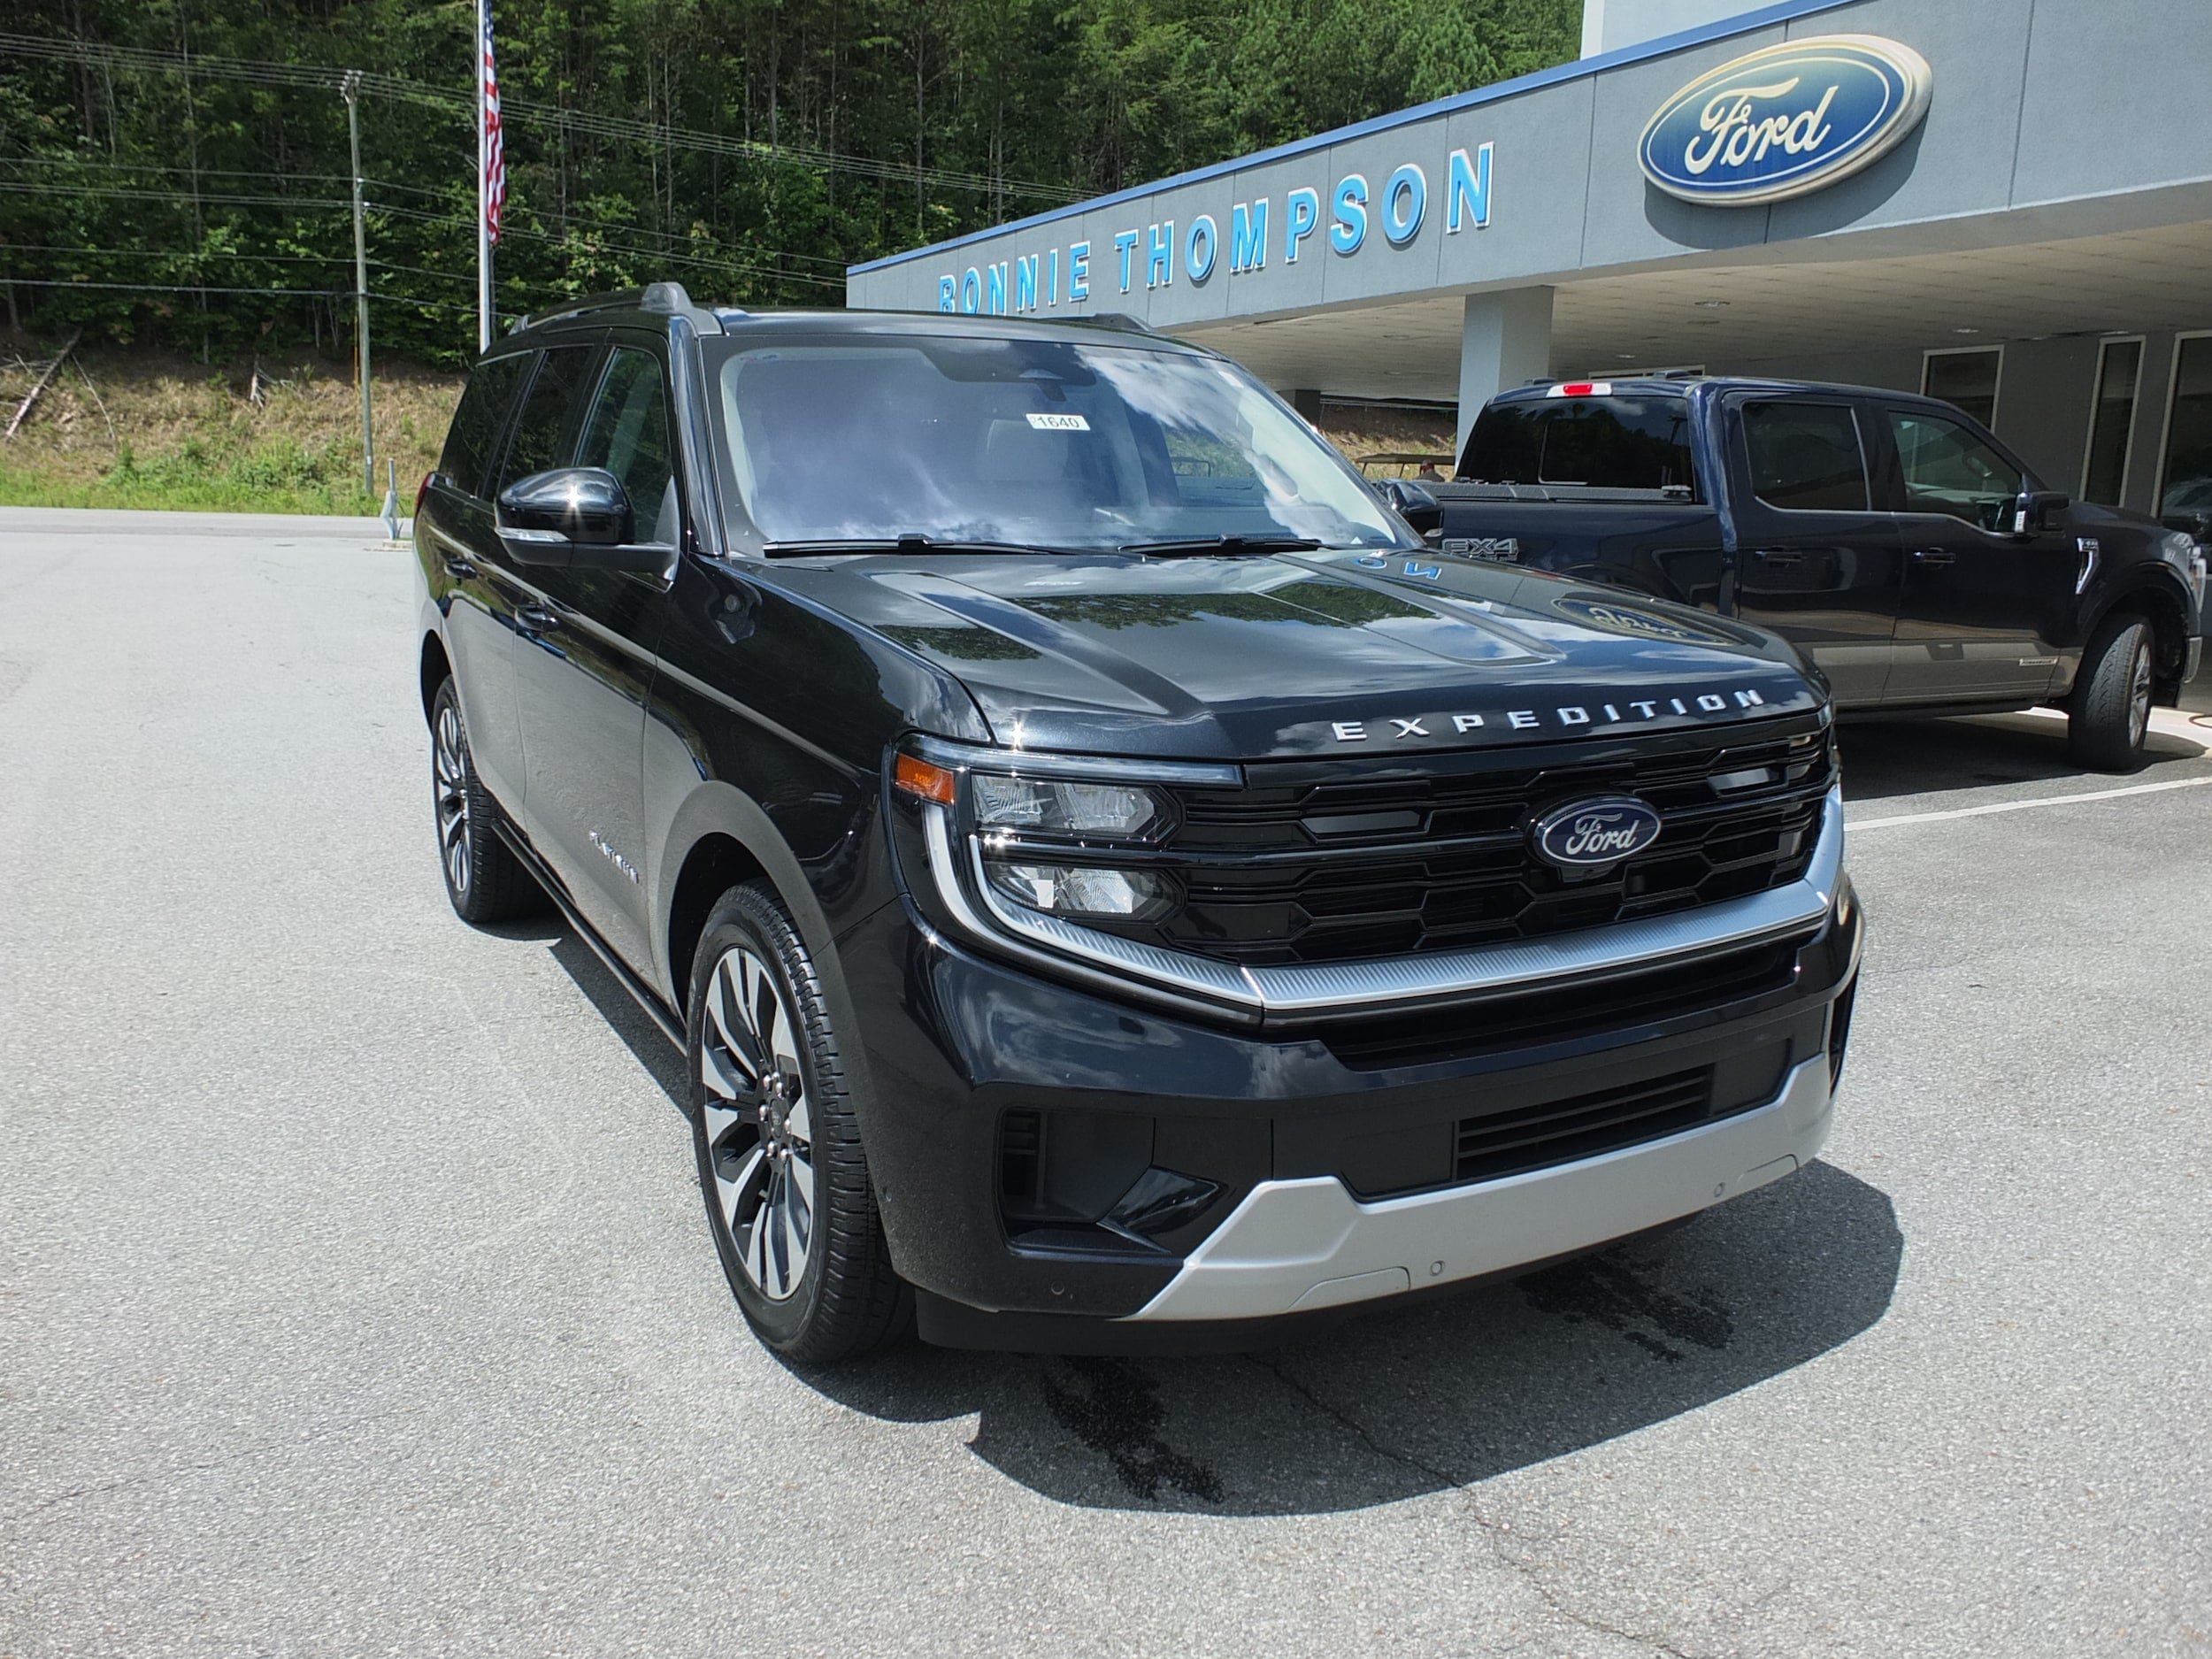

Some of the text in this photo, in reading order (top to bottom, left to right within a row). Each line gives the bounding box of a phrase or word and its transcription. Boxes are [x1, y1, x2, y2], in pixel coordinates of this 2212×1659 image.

[1685, 77, 1839, 174] Ford
[940, 142, 1494, 316] BONNIE THOMPSON
[1037, 416, 1079, 428] 1640
[1442, 538, 1519, 557] FX4
[1332, 689, 1765, 742] EXPEDITION
[1565, 812, 1640, 855] Ford
